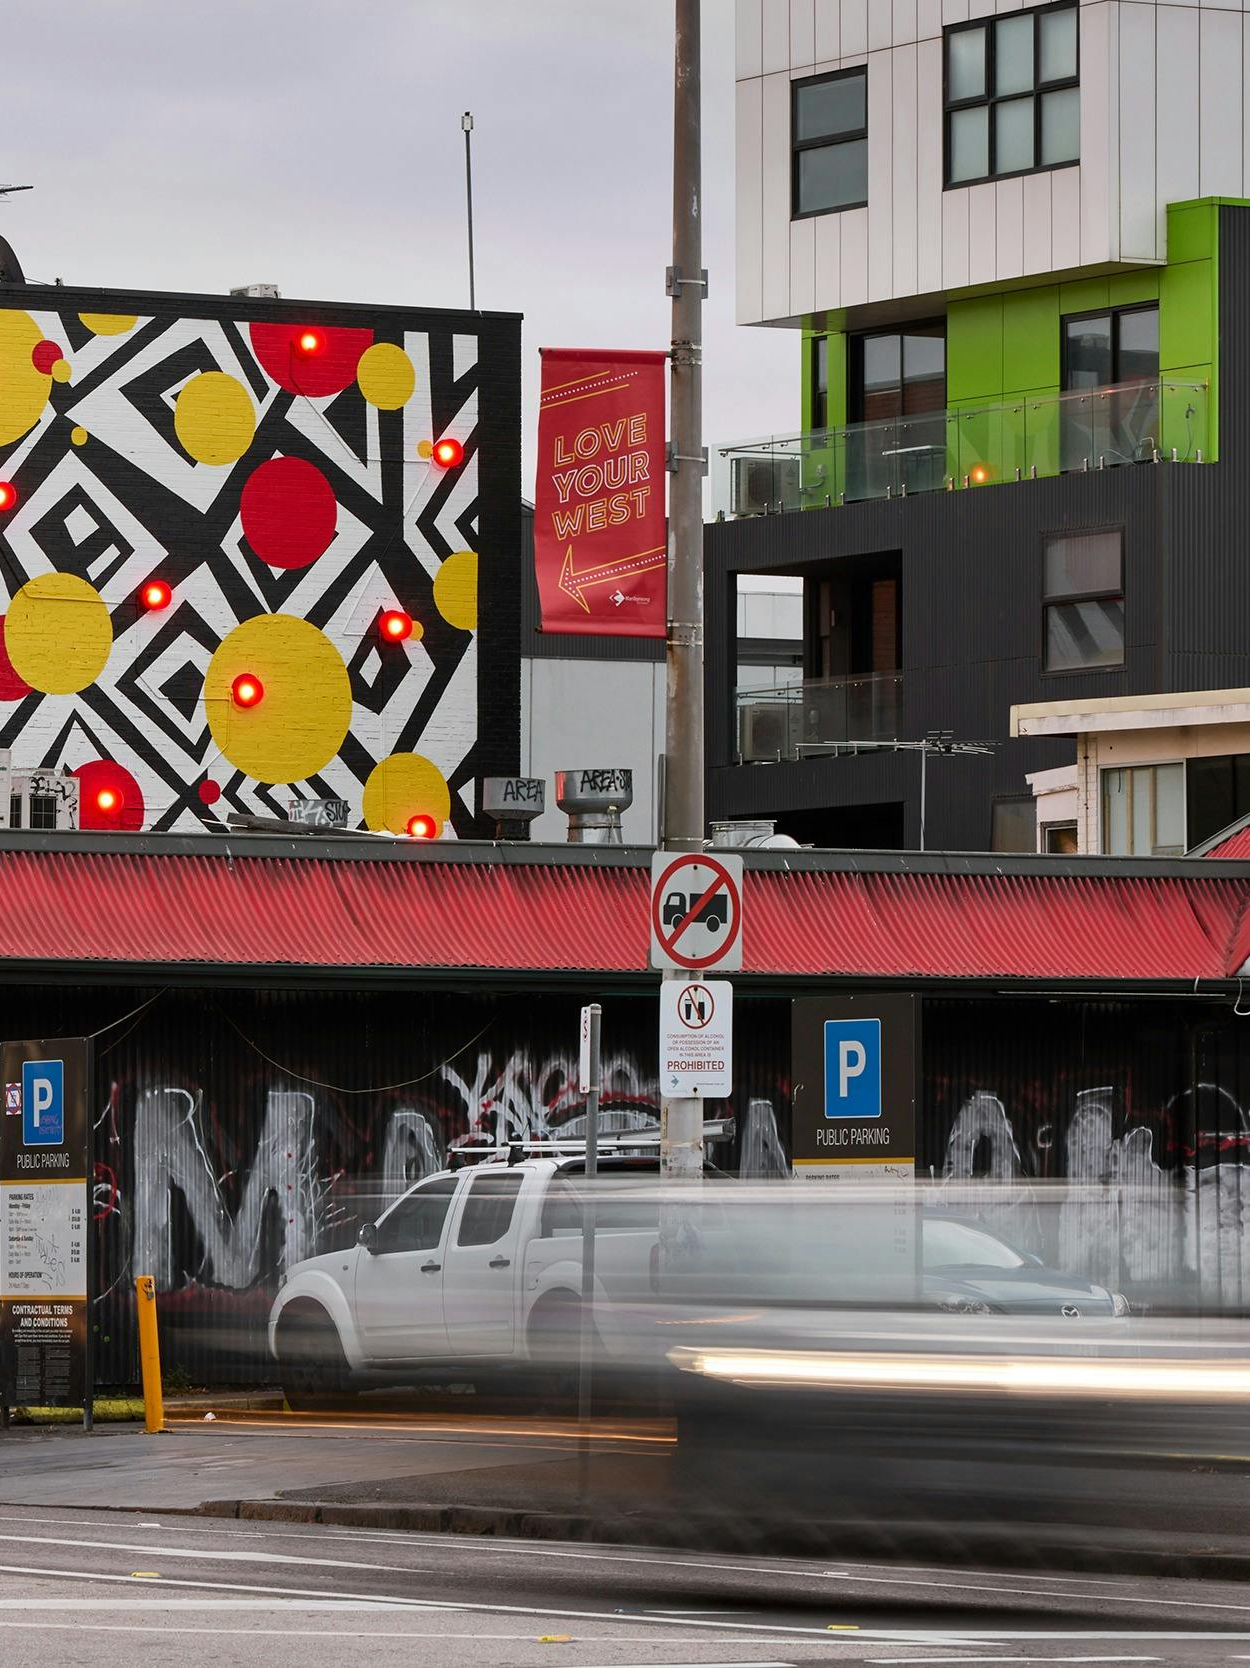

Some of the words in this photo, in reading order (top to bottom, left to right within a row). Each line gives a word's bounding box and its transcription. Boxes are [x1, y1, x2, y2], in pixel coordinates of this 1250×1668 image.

[554, 412, 647, 468] LOVE
[552, 450, 650, 503] YOUR
[552, 485, 651, 541] WEST
[503, 779, 543, 803] AREA
[667, 1060, 725, 1071] PROHIBITED
[839, 1040, 867, 1098] P
[33, 1079, 54, 1128] P
[816, 1128, 849, 1146] PUBLIC
[851, 1127, 890, 1145] PARKING
[16, 1154, 41, 1169] PUBLIC
[41, 1153, 70, 1168] PARKING
[12, 1304, 52, 1315] CONTRACTUAL
[53, 1304, 73, 1315] TERMS
[20, 1317, 32, 1327] AND
[33, 1317, 68, 1327] CONDITIONS
